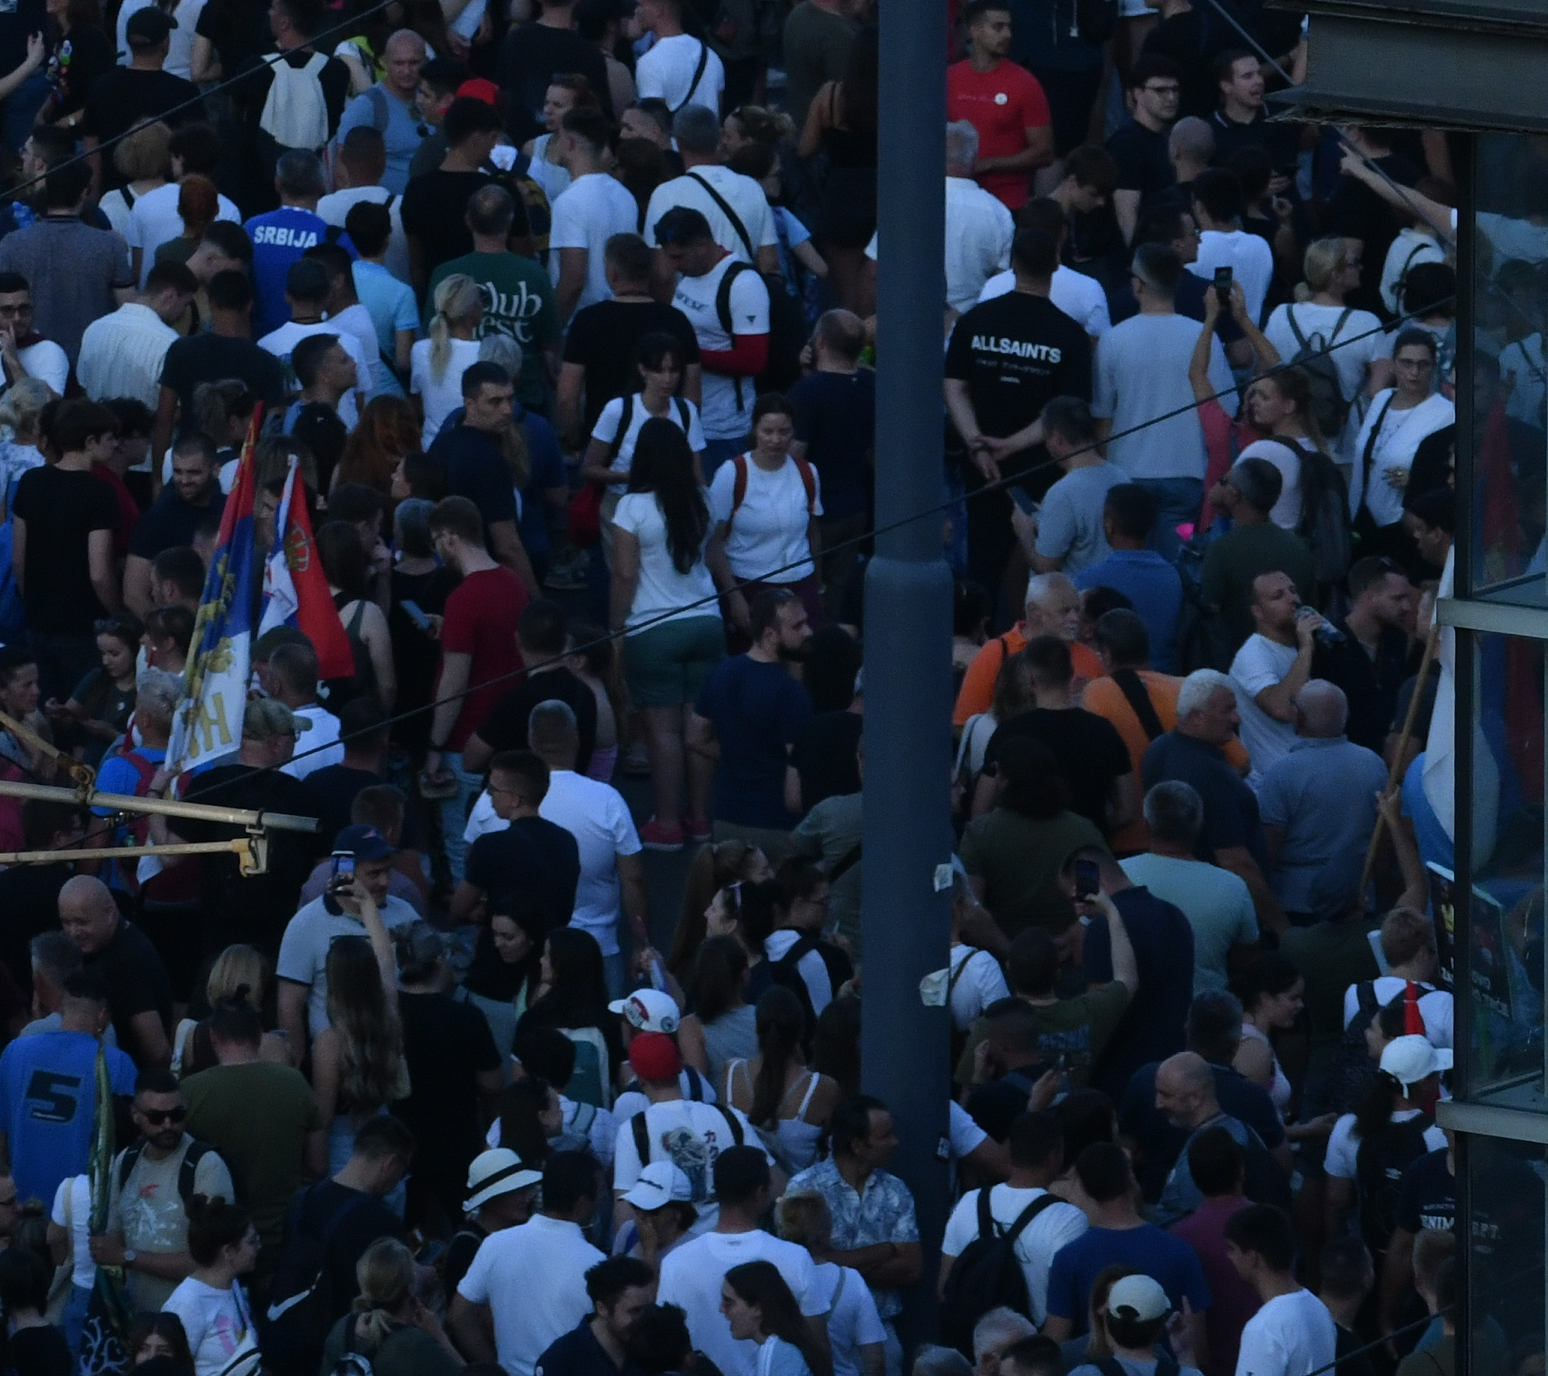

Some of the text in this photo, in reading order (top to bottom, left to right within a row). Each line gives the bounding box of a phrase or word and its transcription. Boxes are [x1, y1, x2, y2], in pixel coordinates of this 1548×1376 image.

[254, 226, 318, 249] SRBIJA
[971, 334, 1062, 365] ALLSAINTS
[26, 1070, 81, 1121] 5
